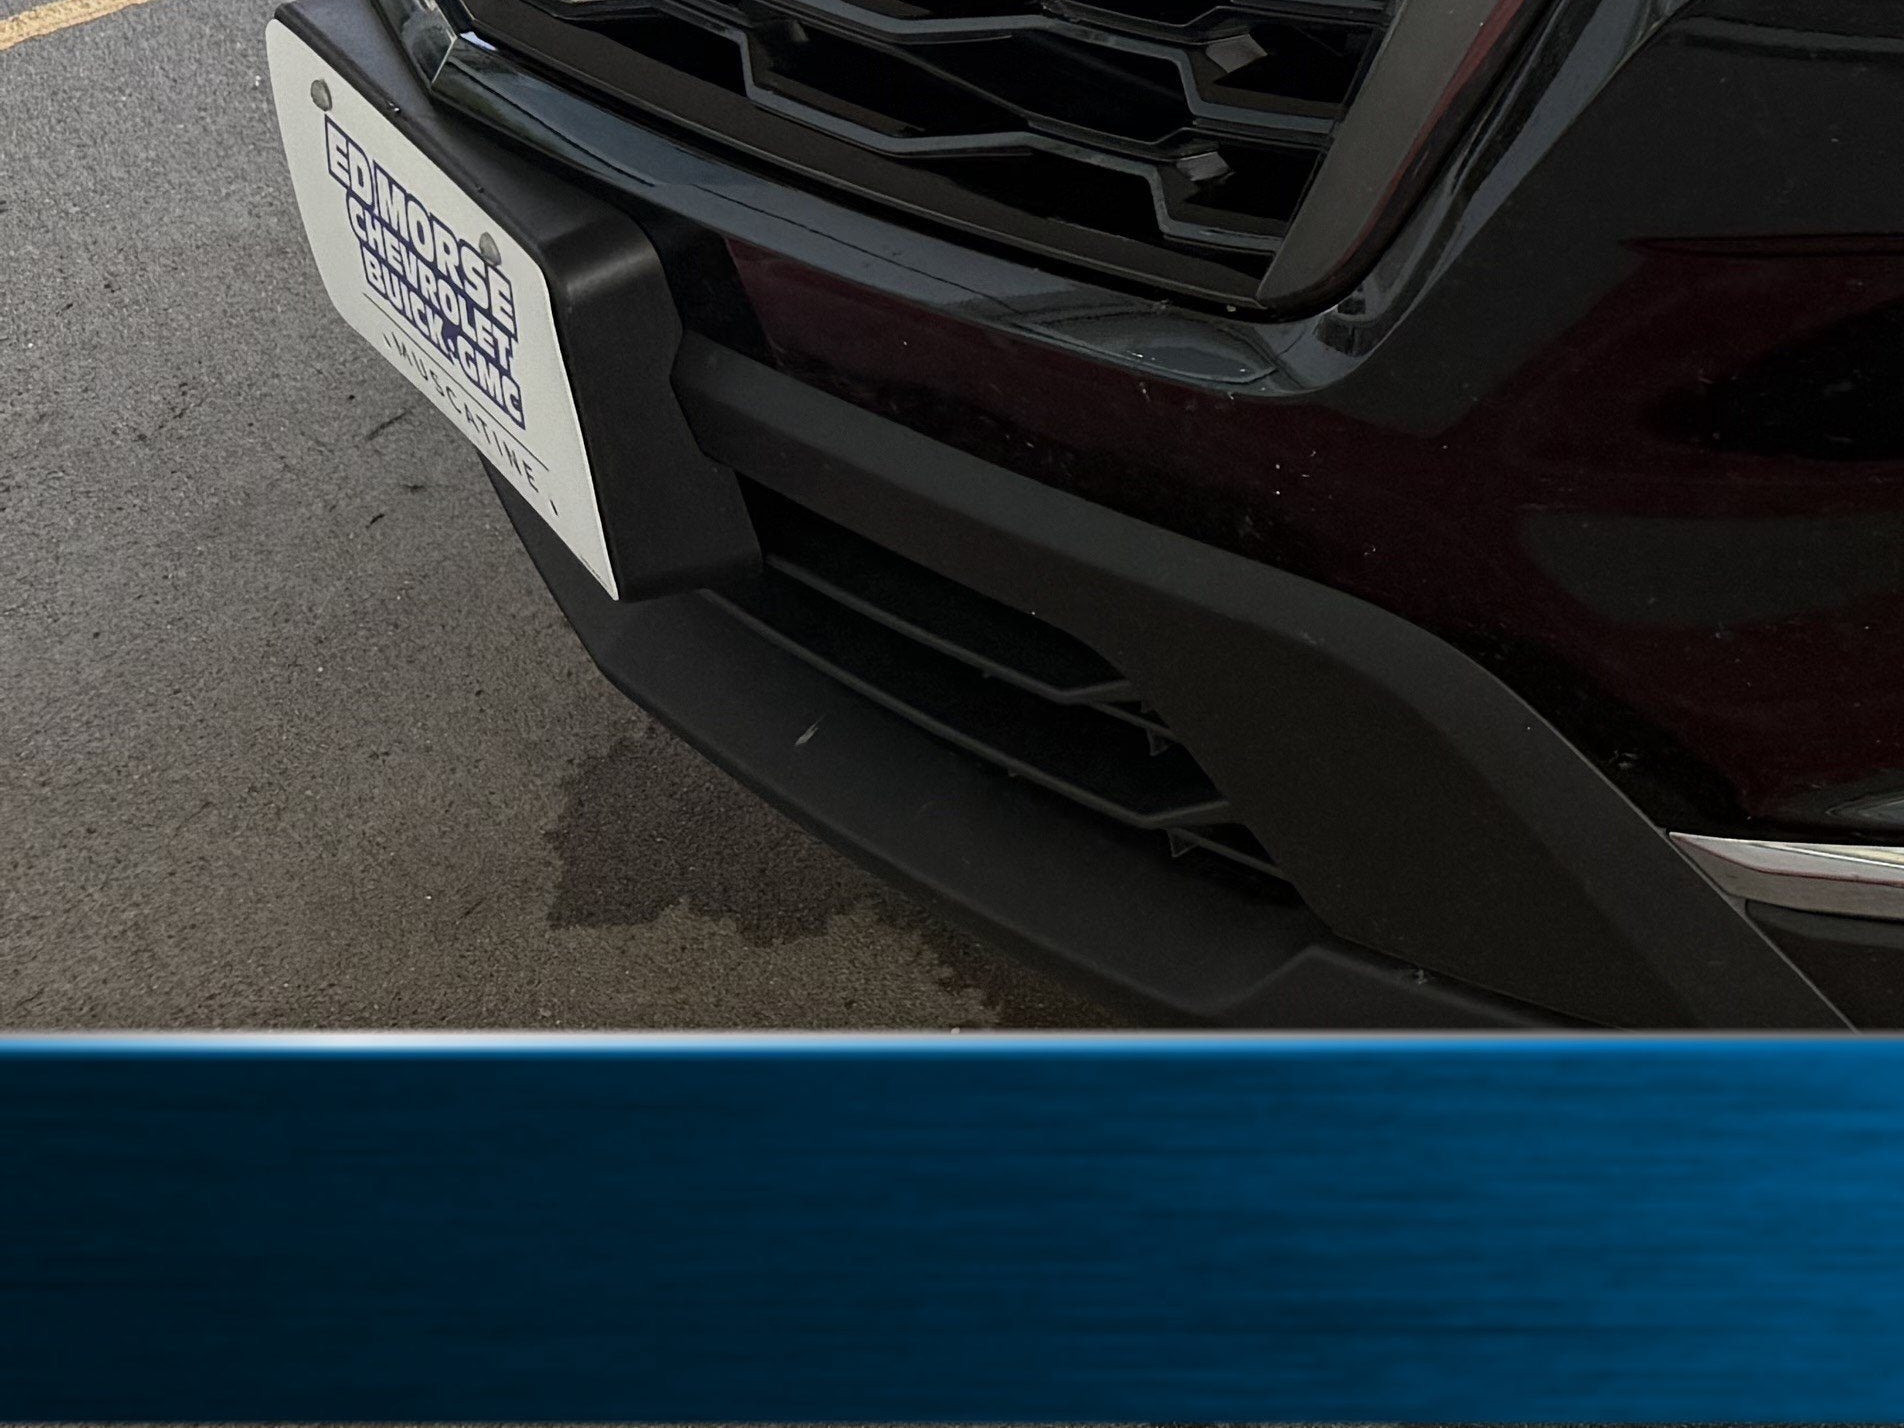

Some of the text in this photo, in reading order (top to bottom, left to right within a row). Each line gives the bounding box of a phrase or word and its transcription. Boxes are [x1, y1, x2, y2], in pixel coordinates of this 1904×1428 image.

[325, 114, 518, 343] ED MORSE
[346, 192, 514, 378] CHEVROLET
[361, 244, 526, 430] BUICK GMC
[391, 331, 539, 493] MUSCATINE
